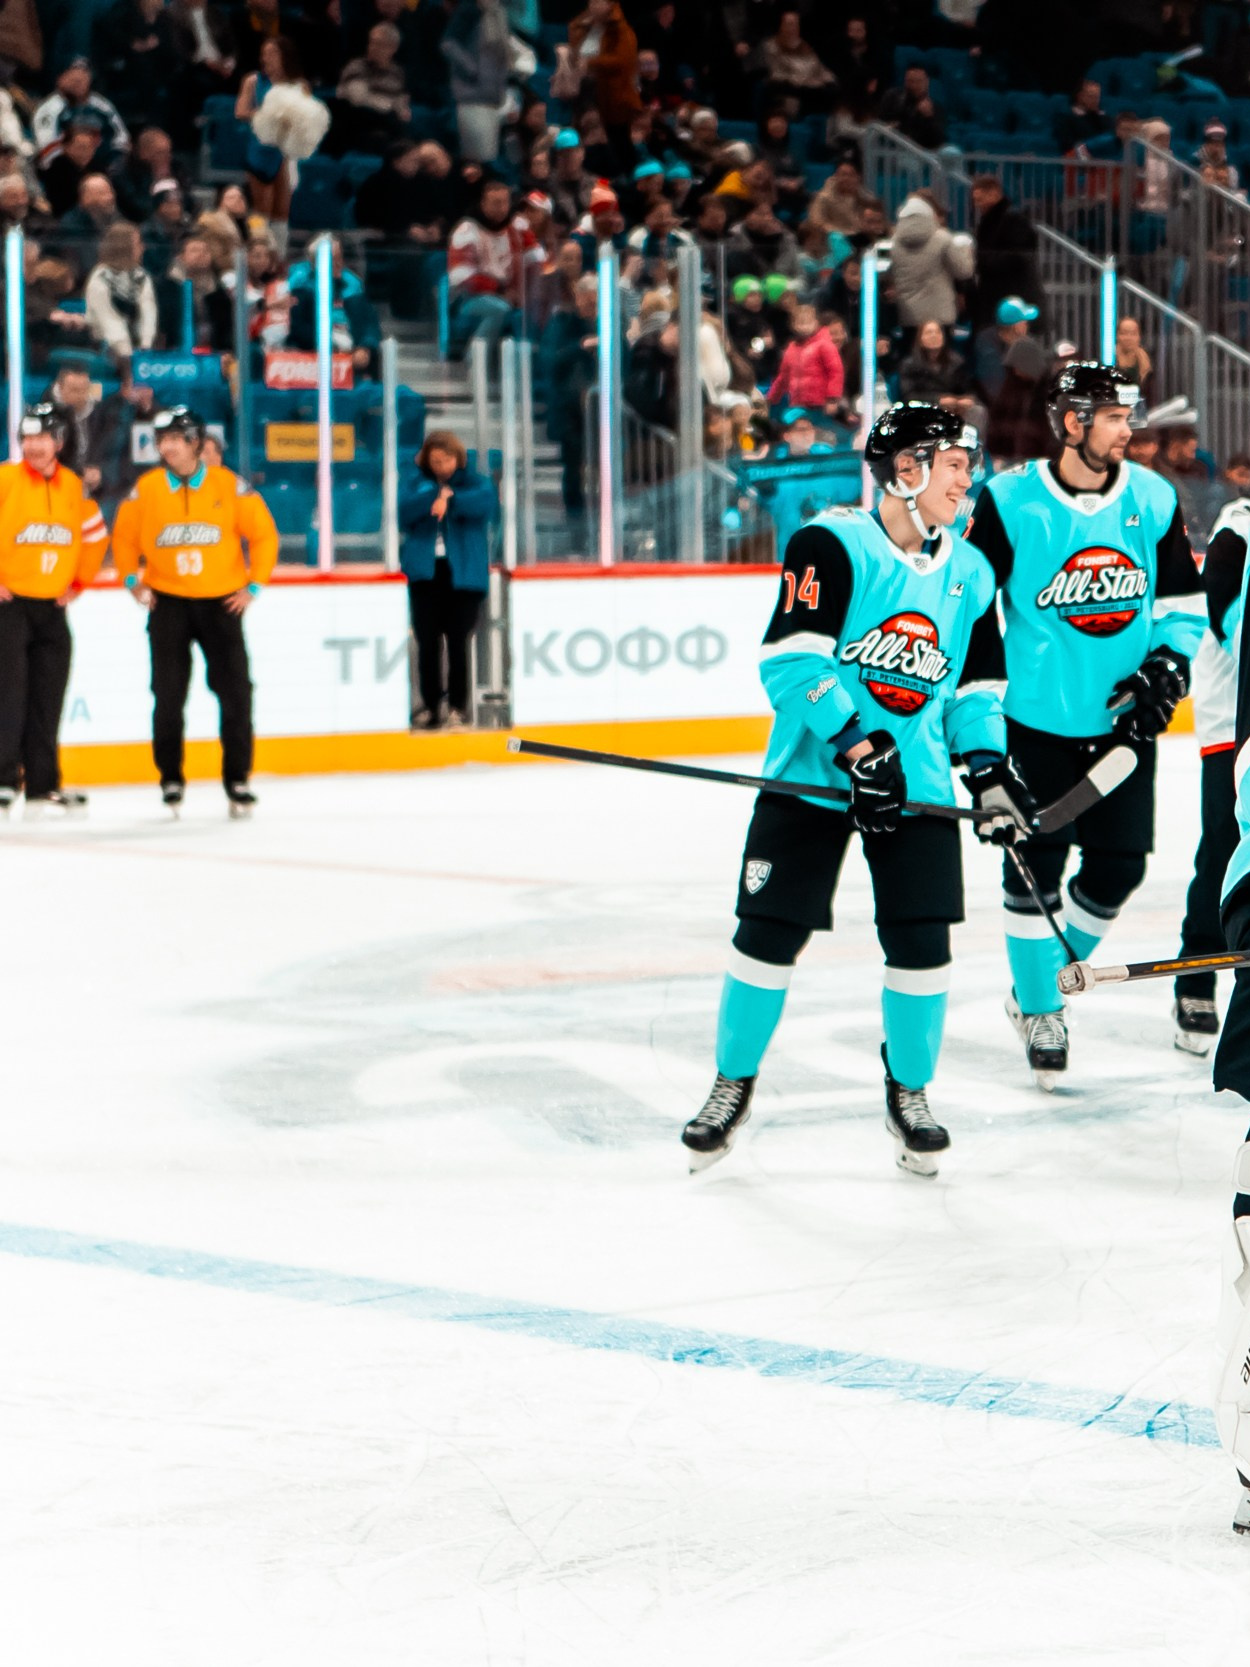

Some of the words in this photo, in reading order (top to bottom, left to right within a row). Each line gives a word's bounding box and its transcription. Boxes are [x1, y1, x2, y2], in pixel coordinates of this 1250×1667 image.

[1077, 555, 1119, 567] FONBET
[784, 566, 820, 614] 14
[1037, 566, 1148, 607] All-Star
[896, 621, 934, 637] FONBET
[840, 629, 948, 681] All-Star
